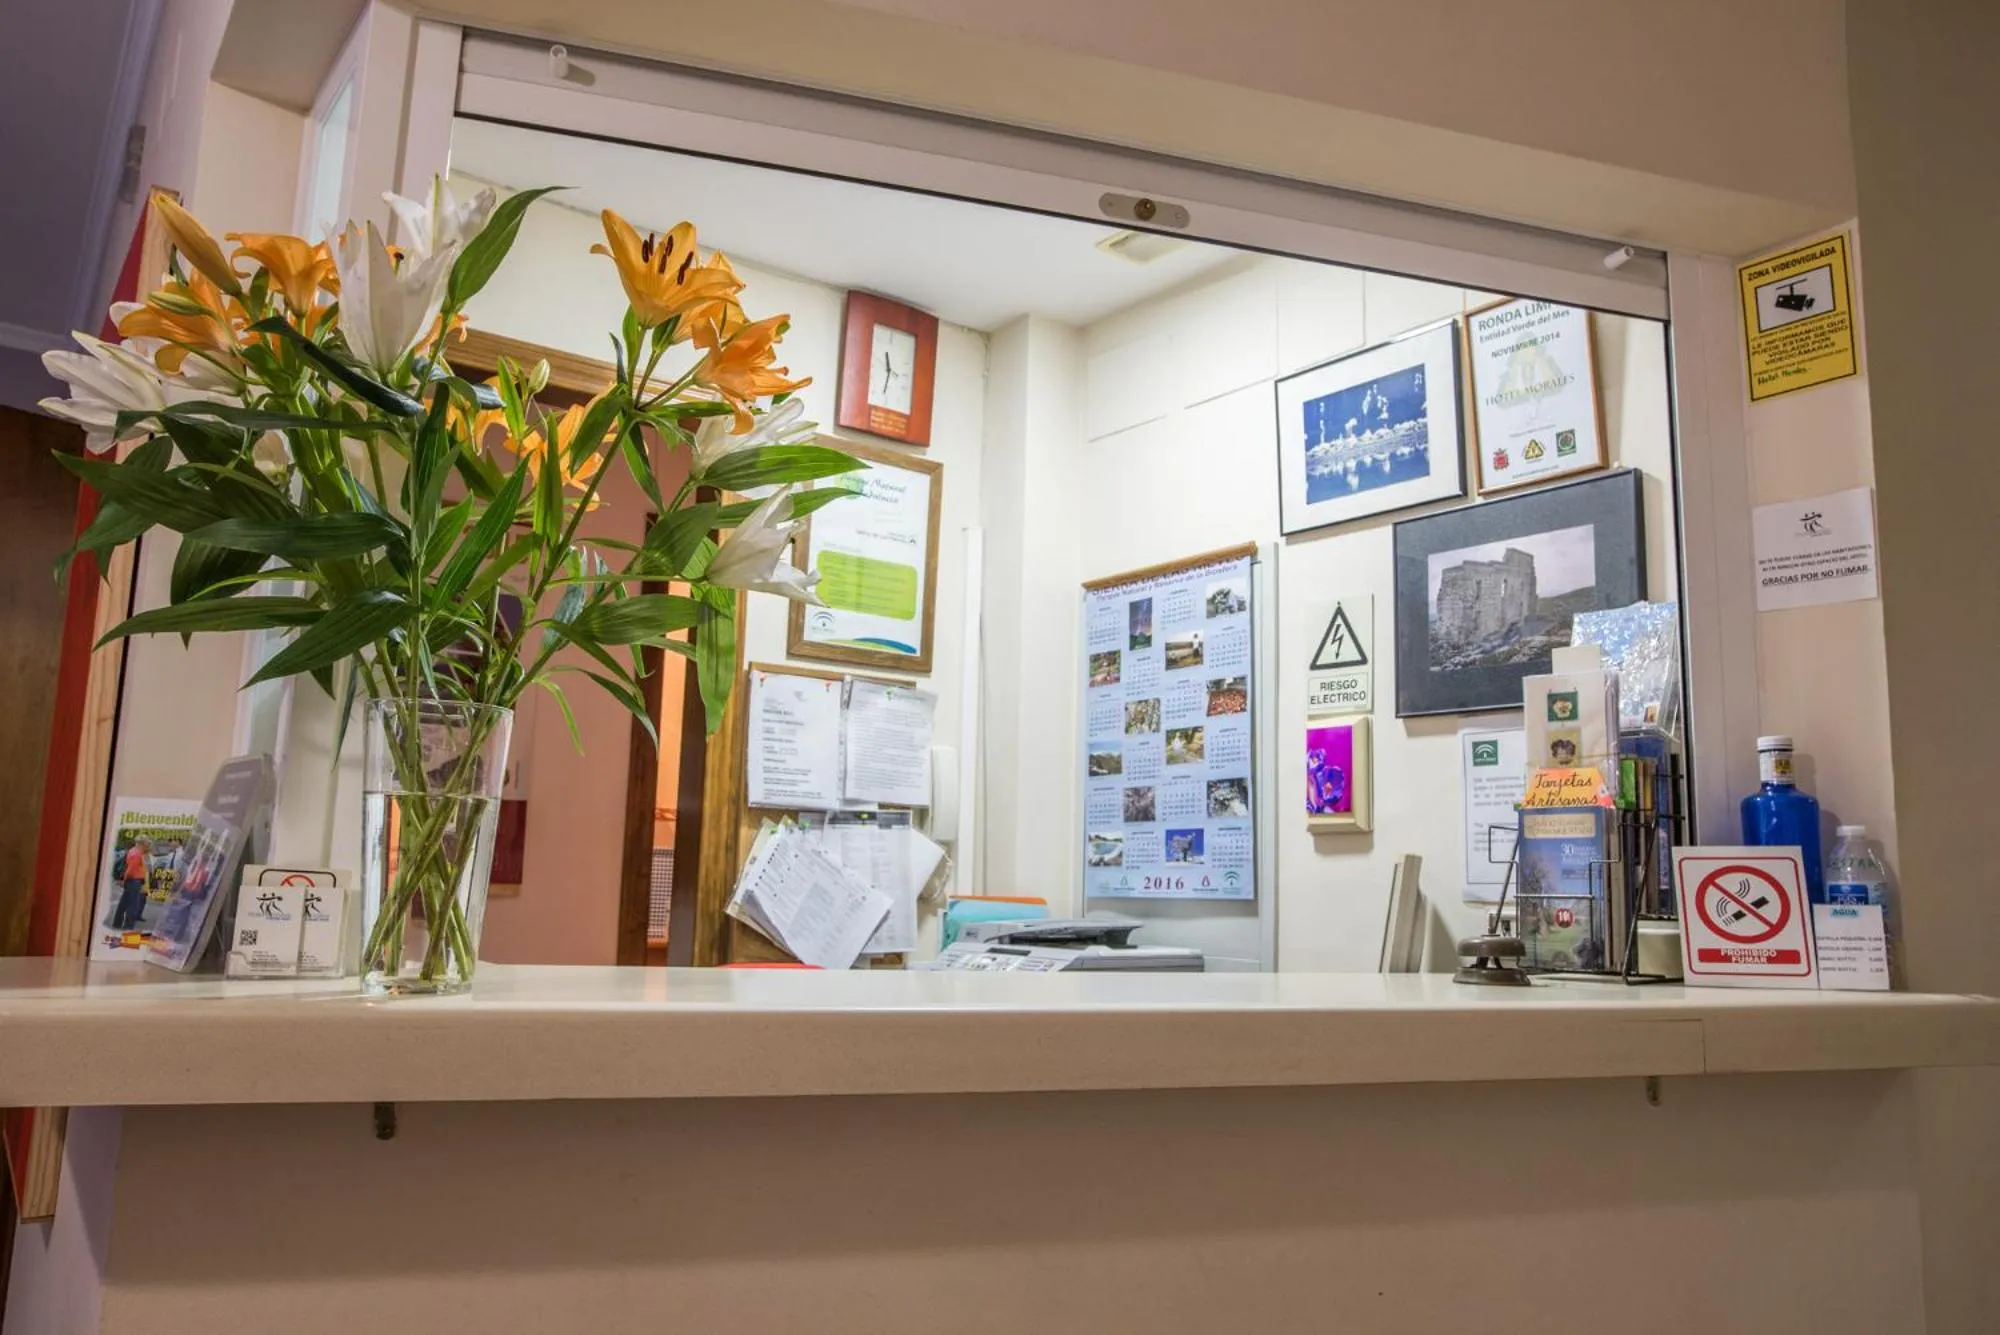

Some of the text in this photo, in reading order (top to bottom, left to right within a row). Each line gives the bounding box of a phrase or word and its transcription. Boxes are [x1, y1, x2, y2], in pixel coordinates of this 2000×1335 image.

[1748, 247, 1836, 281] ZONA VIDEOVIGILADA
[1478, 301, 1551, 331] RONDA LIM
[1480, 328, 1510, 343] Entidad
[1512, 320, 1535, 332] Verde
[1553, 309, 1570, 320] Mes
[1492, 331, 1560, 358] NOVIEMBRE 2014
[1485, 373, 1575, 406] HOTEL MORALES
[1762, 565, 1868, 587] GRACIAS POR NO FUMAR
[1320, 679, 1358, 691] RIESGO
[1310, 690, 1366, 705] ELECTRICO
[1535, 772, 1592, 796] Tarjetas
[1525, 791, 1598, 806] Artesanas
[1143, 876, 1184, 890] 2016
[1831, 908, 1858, 917] AGUA
[1720, 949, 1777, 957] PROHIBIDO
[1732, 956, 1768, 964] FUMAR
